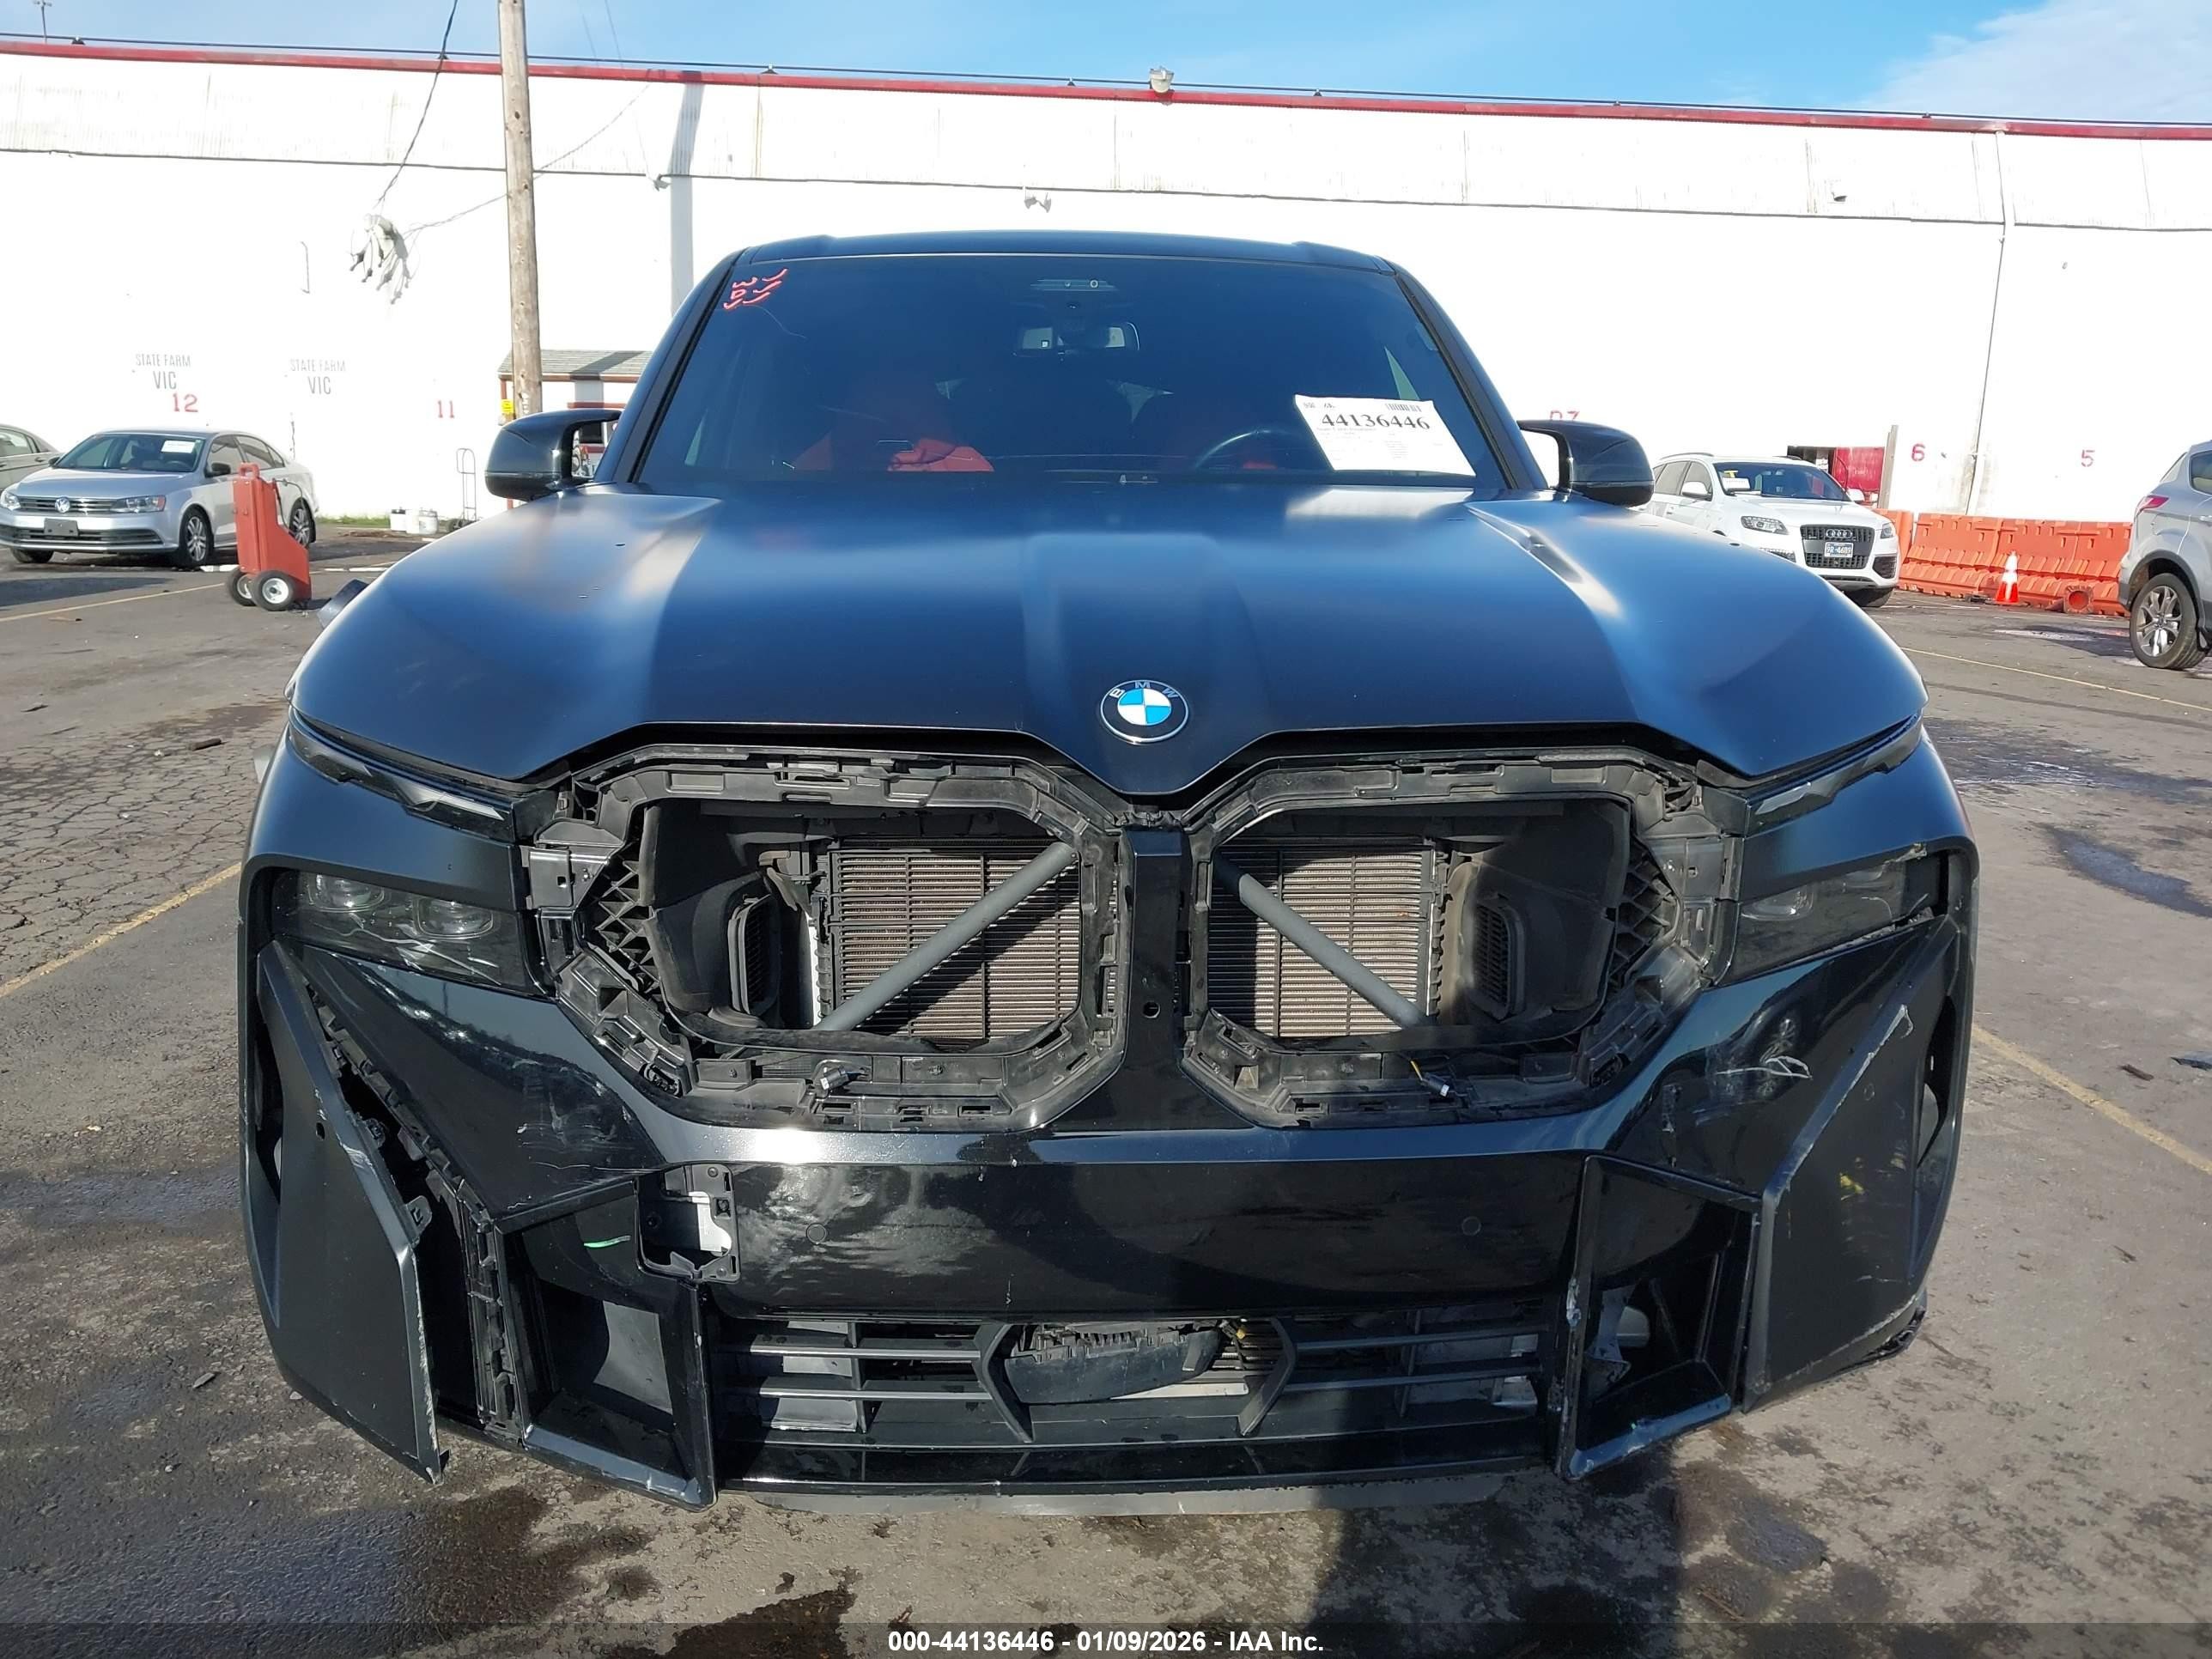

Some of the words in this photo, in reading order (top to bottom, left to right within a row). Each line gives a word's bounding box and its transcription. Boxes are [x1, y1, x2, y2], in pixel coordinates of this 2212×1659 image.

[135, 353, 161, 367] STATE
[164, 354, 191, 368] FARM
[289, 359, 317, 372] STATE
[152, 370, 177, 390] VIC
[307, 375, 331, 395] VIC
[172, 392, 199, 413] 12
[436, 399, 455, 419] 11
[1321, 413, 1431, 430] 44136446
[1911, 443, 1926, 462] 6
[2081, 449, 2095, 467] 5
[1109, 681, 1179, 699] BMW
